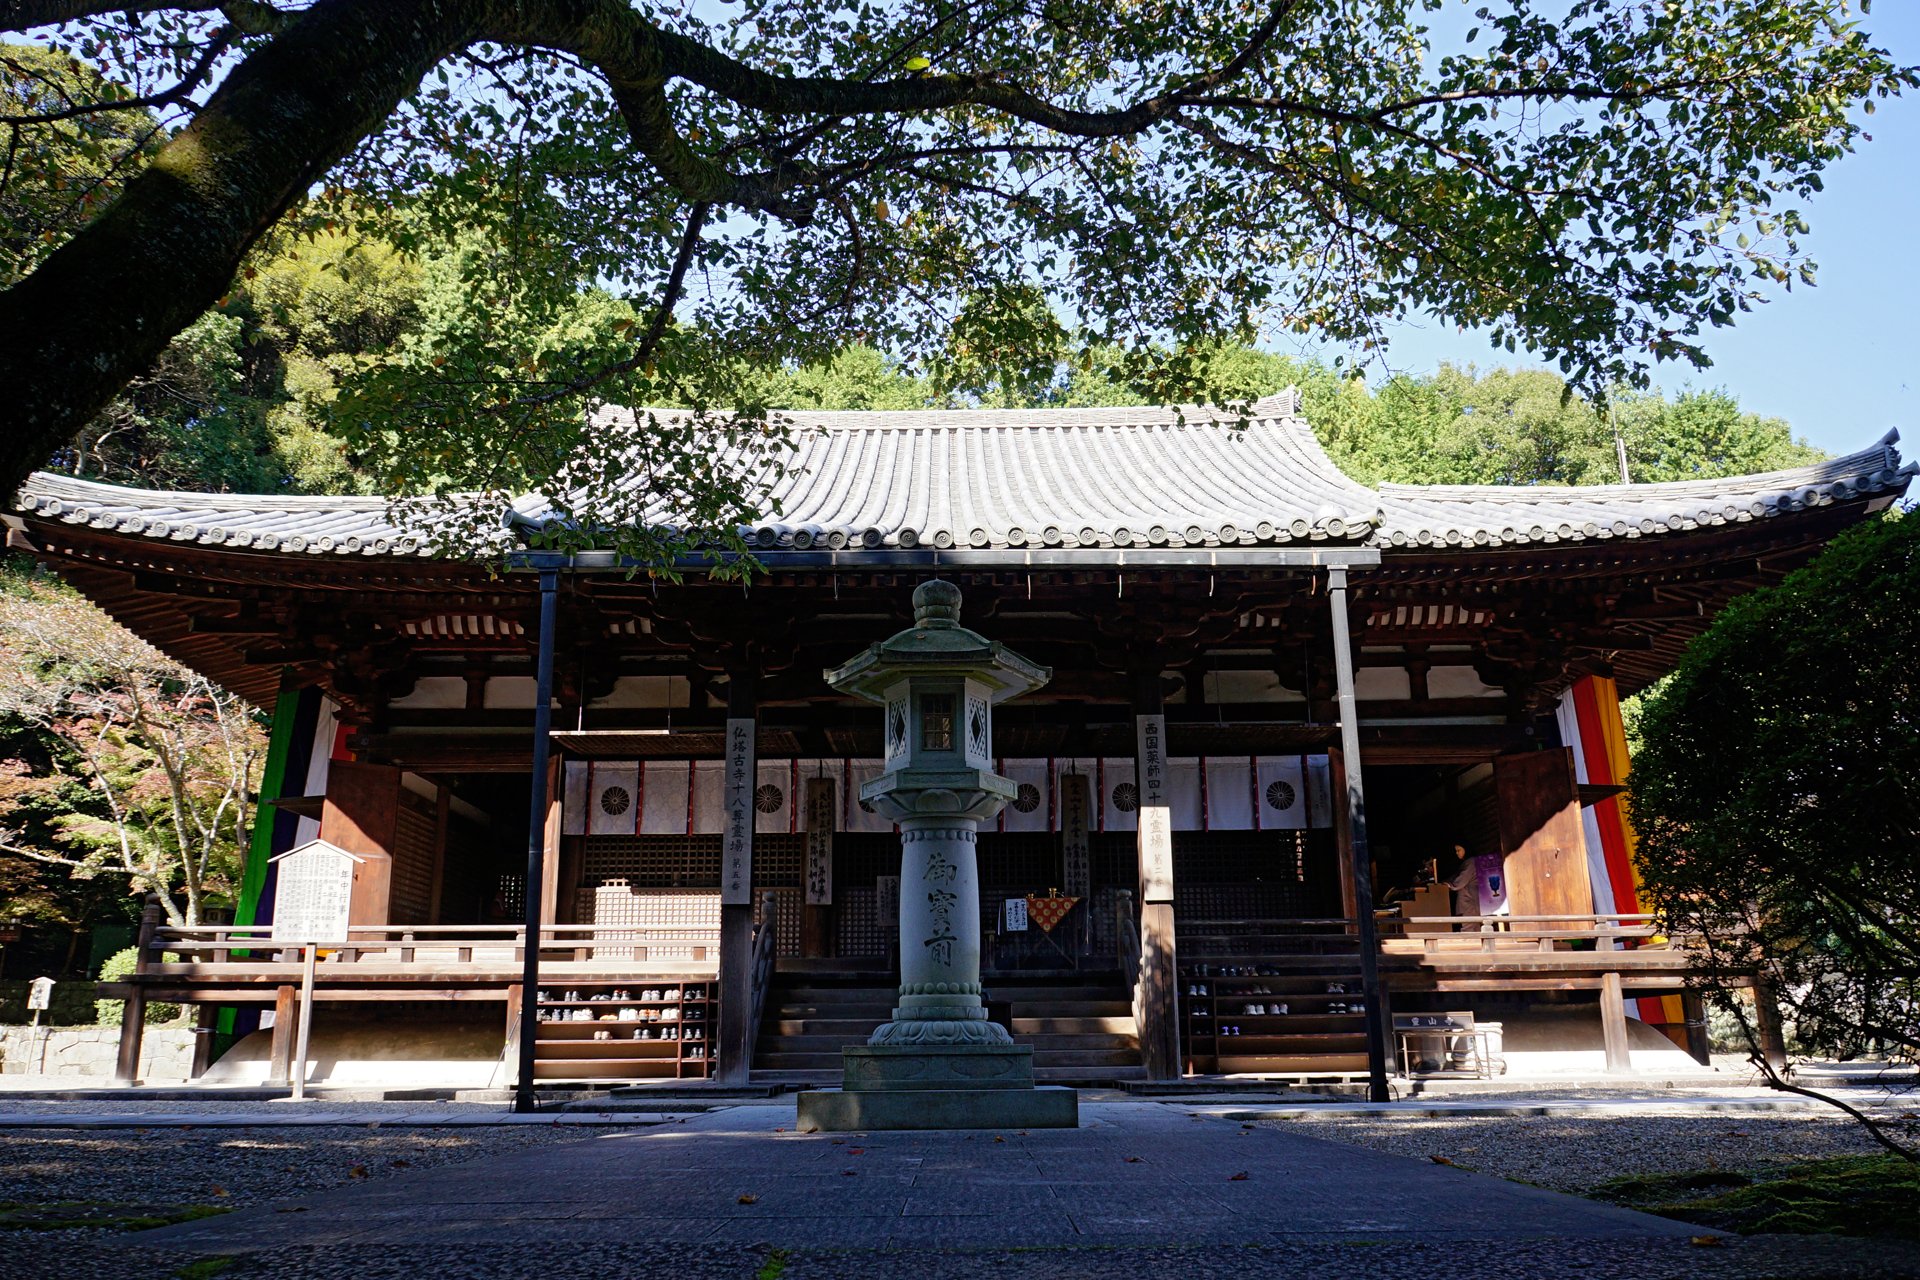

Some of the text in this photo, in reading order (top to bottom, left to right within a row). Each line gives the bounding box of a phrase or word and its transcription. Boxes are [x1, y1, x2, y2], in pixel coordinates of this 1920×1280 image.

[1144, 722, 1164, 848] 西国薬師四十九霊場
[339, 869, 350, 916] 年中行事
